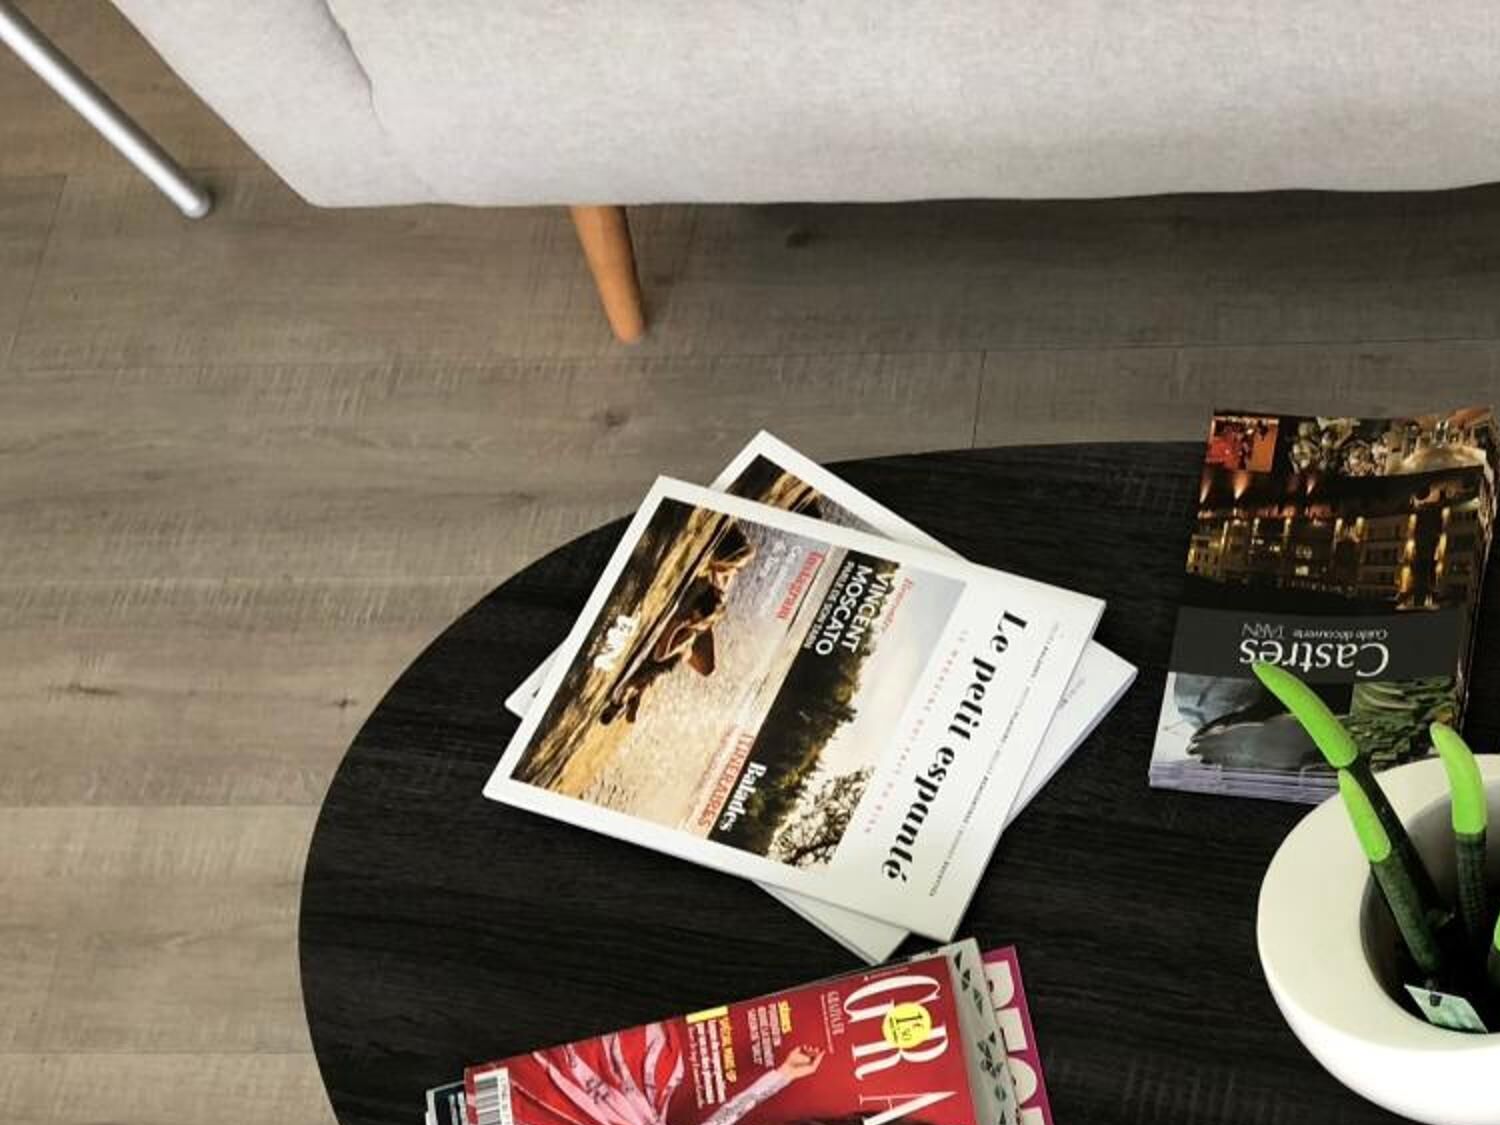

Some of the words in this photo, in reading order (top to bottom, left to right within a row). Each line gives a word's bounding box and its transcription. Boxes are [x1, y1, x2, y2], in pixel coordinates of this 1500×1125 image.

[811, 563, 874, 657] MOSCATO
[838, 569, 894, 653] VINCENT
[985, 611, 1029, 657] Le
[937, 656, 1006, 743] petit
[1233, 638, 1392, 677] Castres
[715, 760, 768, 834] Balades
[869, 742, 966, 883] espanté
